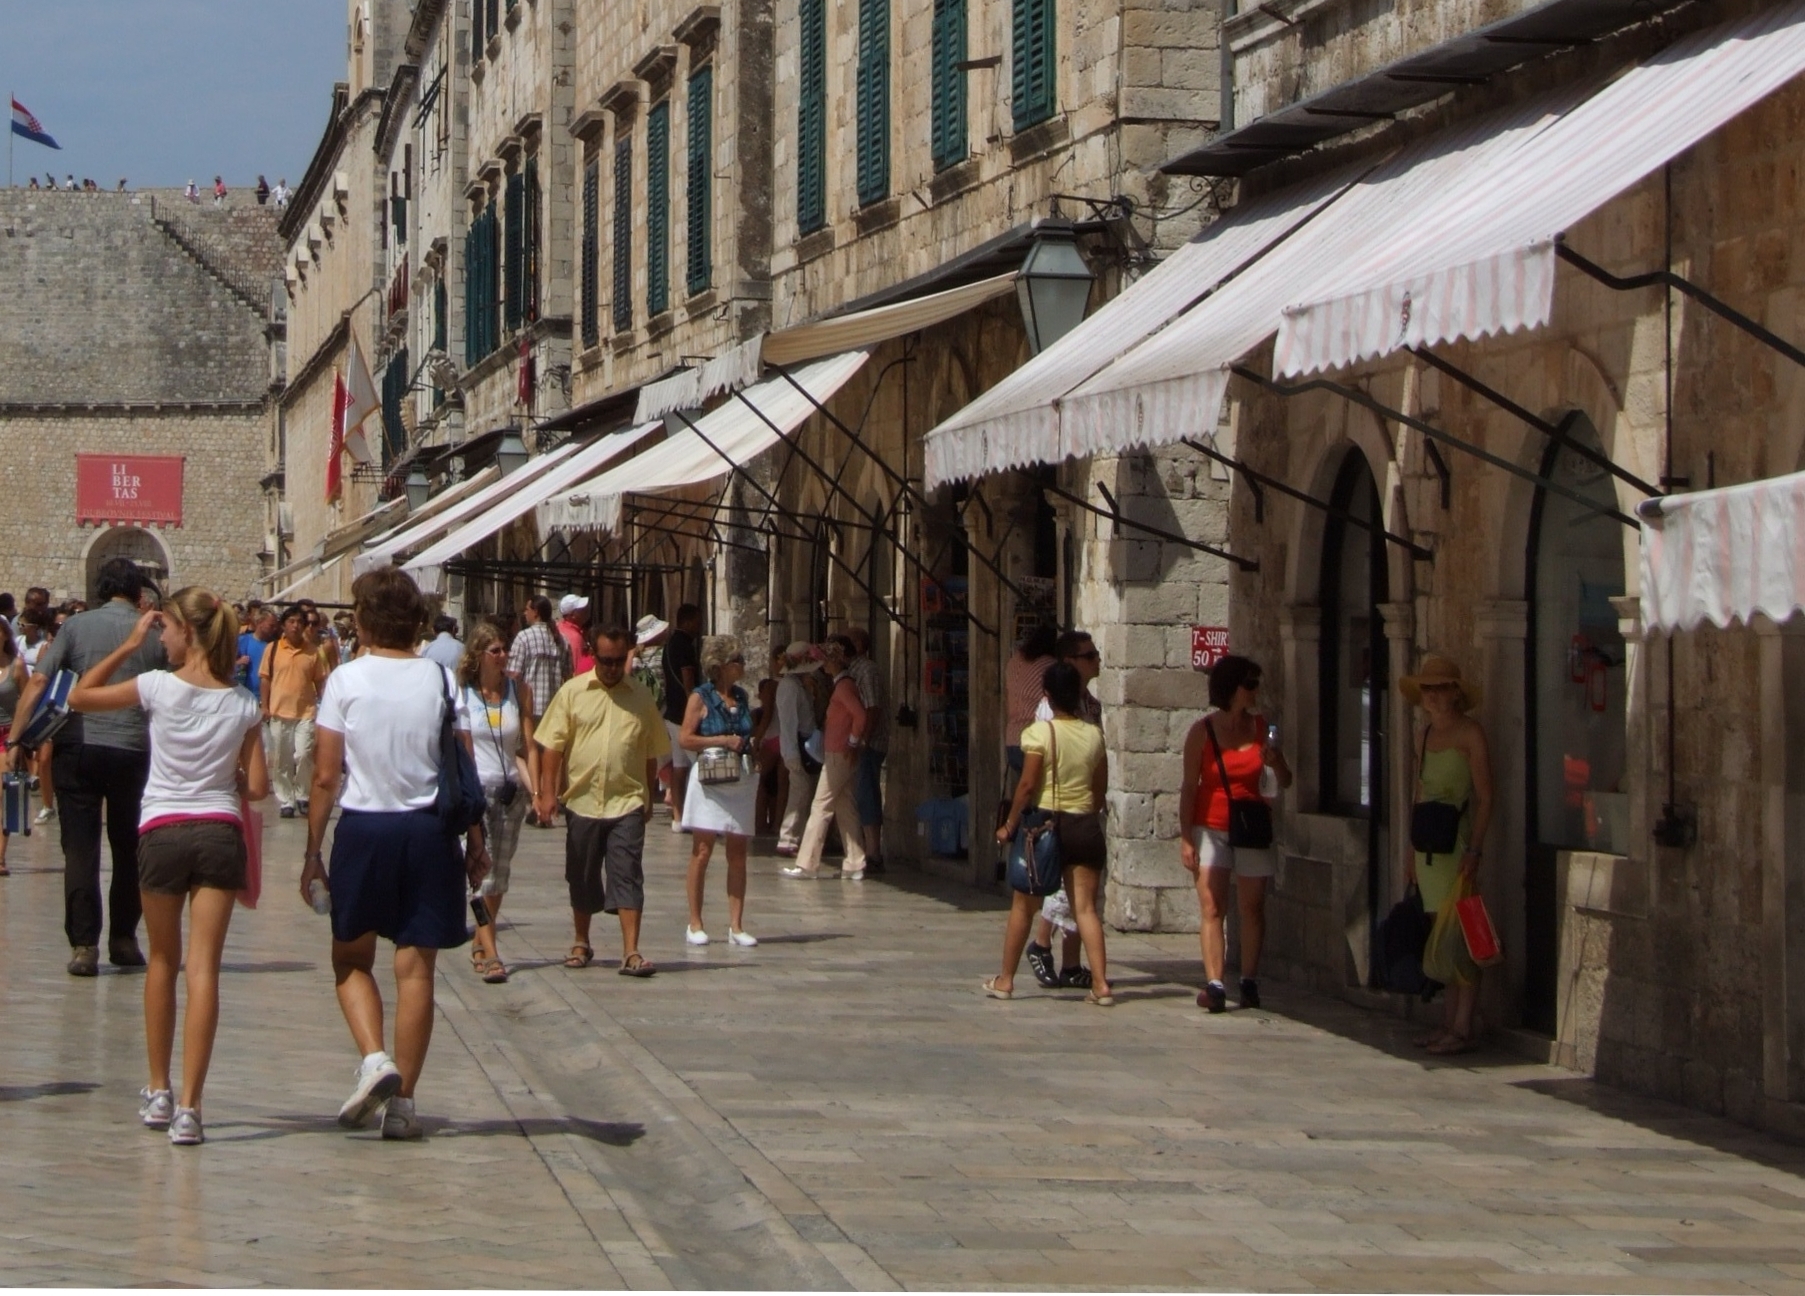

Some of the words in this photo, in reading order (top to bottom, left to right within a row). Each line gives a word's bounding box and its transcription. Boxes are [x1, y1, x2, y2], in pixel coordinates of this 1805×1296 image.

[111, 463, 126, 475] LI
[111, 475, 142, 487] BER
[112, 487, 138, 499] TAS
[1192, 630, 1229, 647] T-SHIR
[1193, 650, 1209, 666] 50
